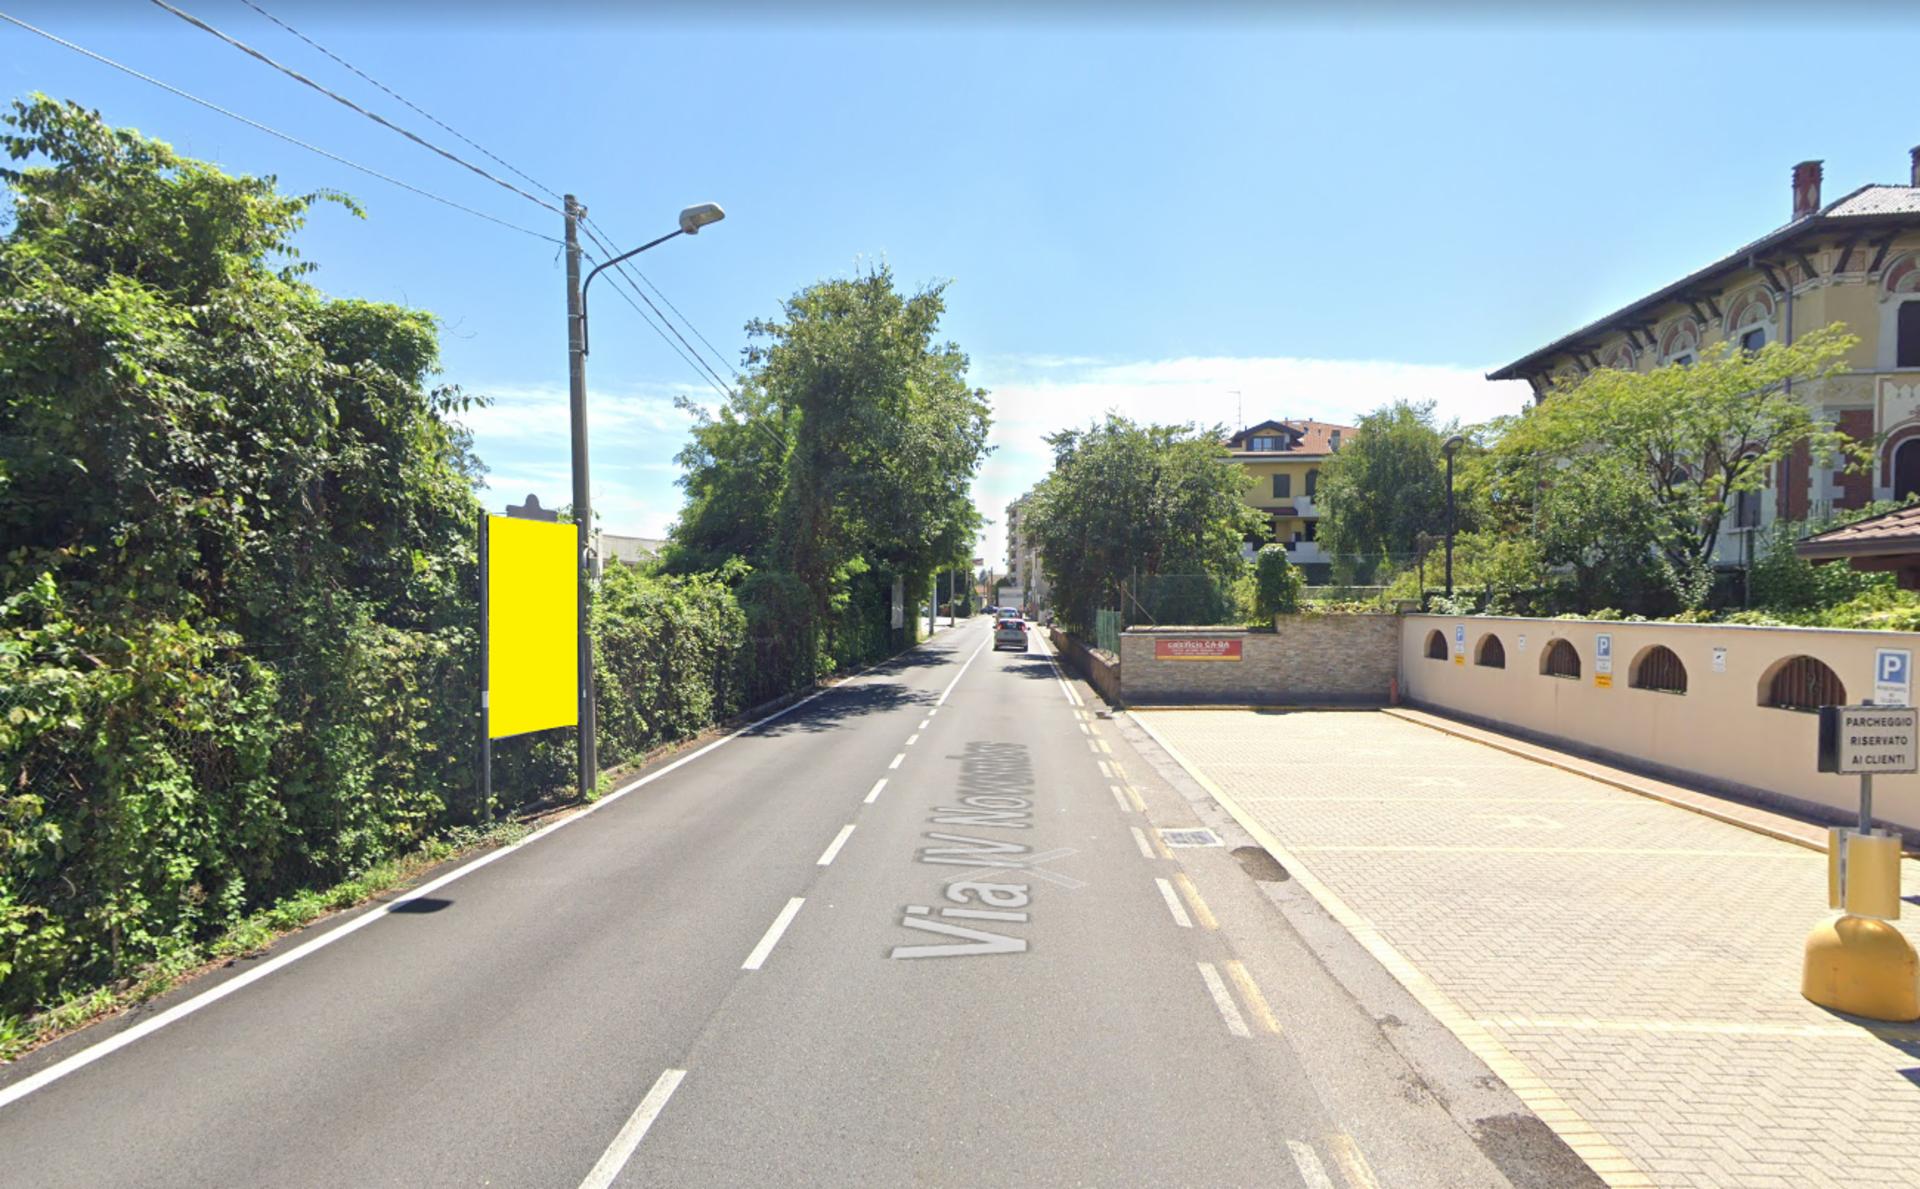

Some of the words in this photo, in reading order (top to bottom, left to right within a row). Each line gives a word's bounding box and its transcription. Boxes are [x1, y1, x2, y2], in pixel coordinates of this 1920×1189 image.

[1600, 637, 1608, 655] P
[1883, 655, 1901, 680] P
[1846, 717, 1912, 727] PARCHEGGIO
[1850, 736, 1908, 746] RISERVATO
[1852, 755, 1863, 765] AI
[1865, 754, 1905, 765] CLIENTI
